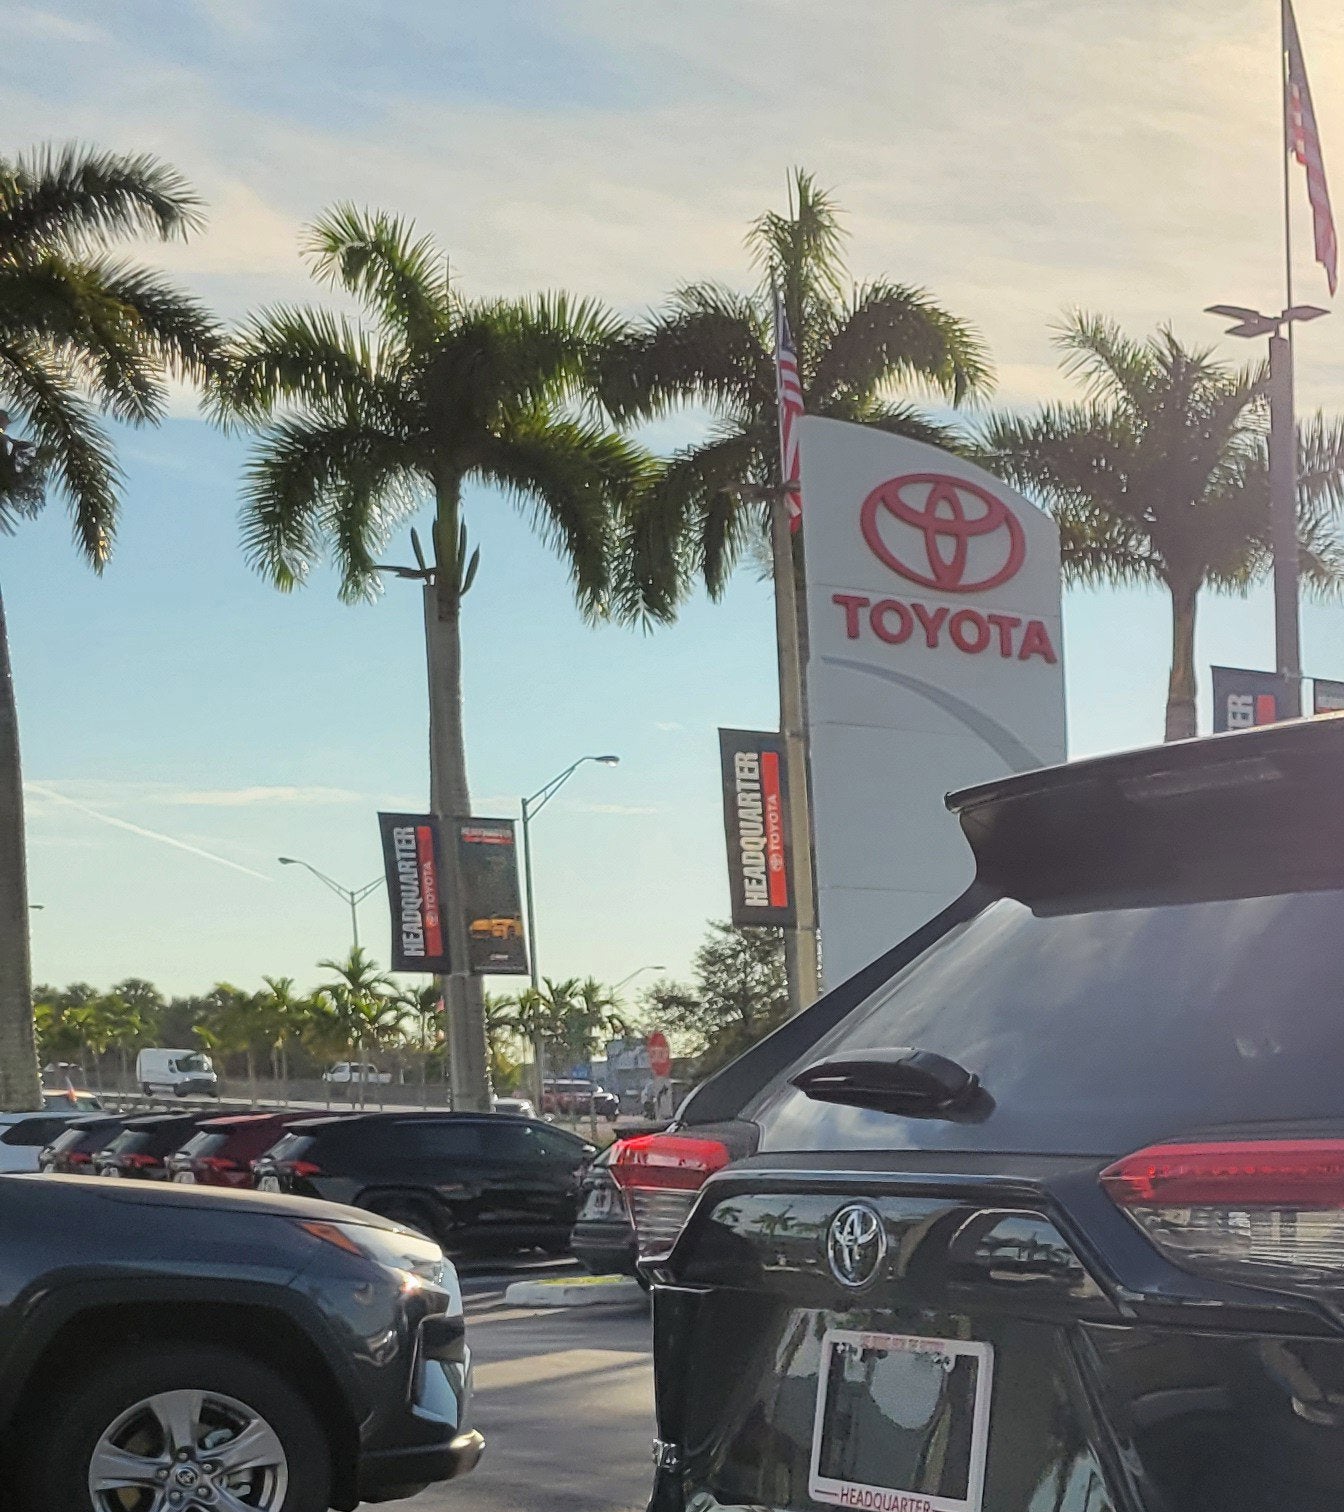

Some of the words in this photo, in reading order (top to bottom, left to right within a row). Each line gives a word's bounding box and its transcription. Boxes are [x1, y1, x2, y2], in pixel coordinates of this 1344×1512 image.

[832, 593, 1058, 665] TOYOTA
[734, 751, 769, 907] HEADQUARTER
[767, 794, 782, 850] TOYOTA
[393, 826, 425, 957] HEADQUARTER
[423, 860, 436, 911] TOYOTA
